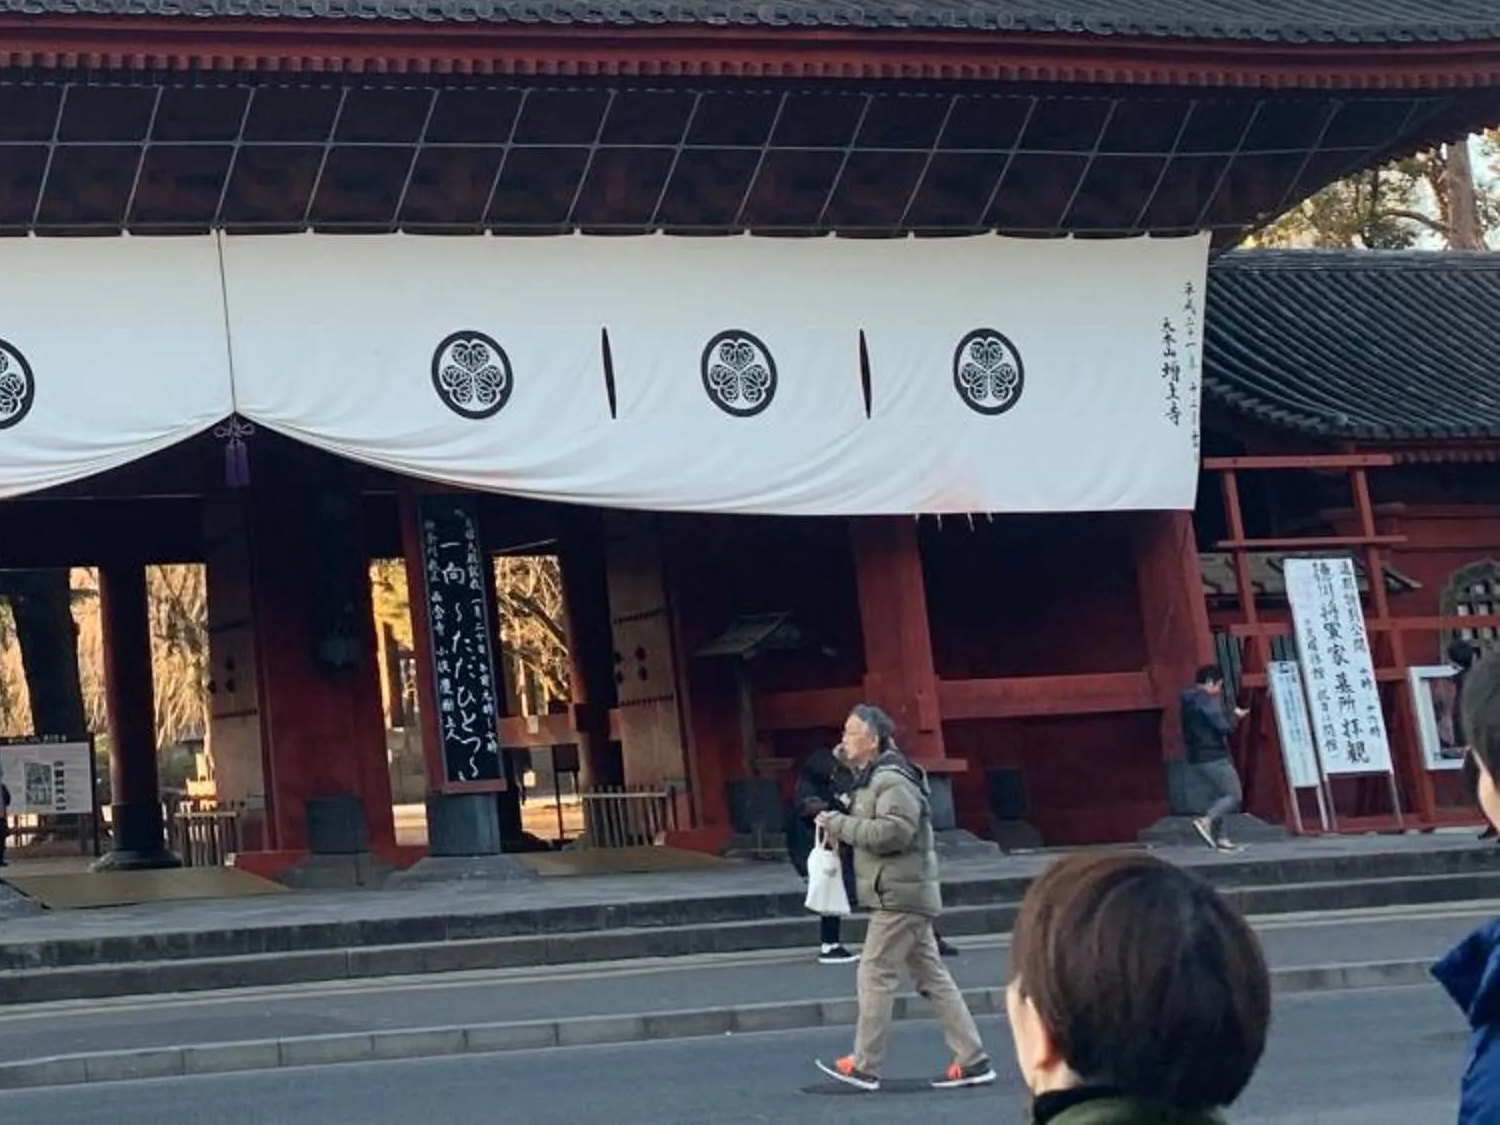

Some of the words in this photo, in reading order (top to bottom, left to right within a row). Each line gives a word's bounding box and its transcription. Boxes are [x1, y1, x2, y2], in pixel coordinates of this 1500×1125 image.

[1161, 316, 1182, 426] 大本山増上寺
